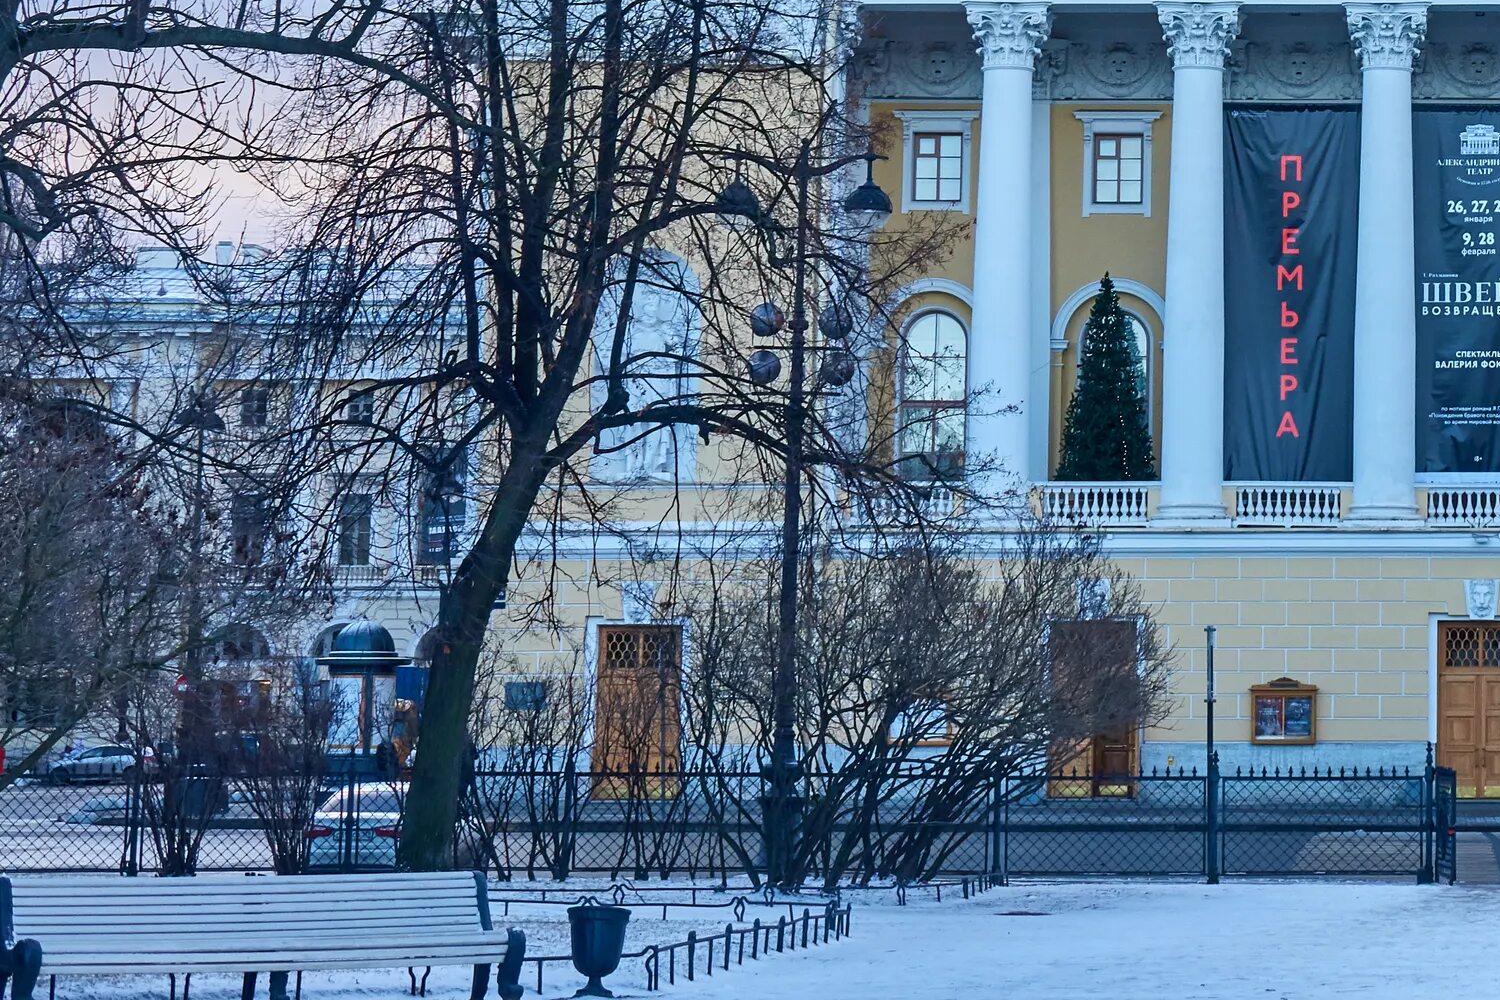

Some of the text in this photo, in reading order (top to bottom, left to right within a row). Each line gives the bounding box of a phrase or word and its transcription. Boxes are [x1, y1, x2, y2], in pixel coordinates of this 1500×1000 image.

[1466, 167, 1493, 175] ТЕАТР
[1447, 199, 1467, 214] 26,
[1471, 199, 1489, 214] 27,
[1464, 216, 1493, 224] января
[1462, 232, 1495, 247] 9, 28
[1461, 247, 1496, 256] февраля
[1276, 155, 1304, 437] ПРЕМЬЕРА
[1435, 360, 1478, 369] ВАЛЕРИЯ
